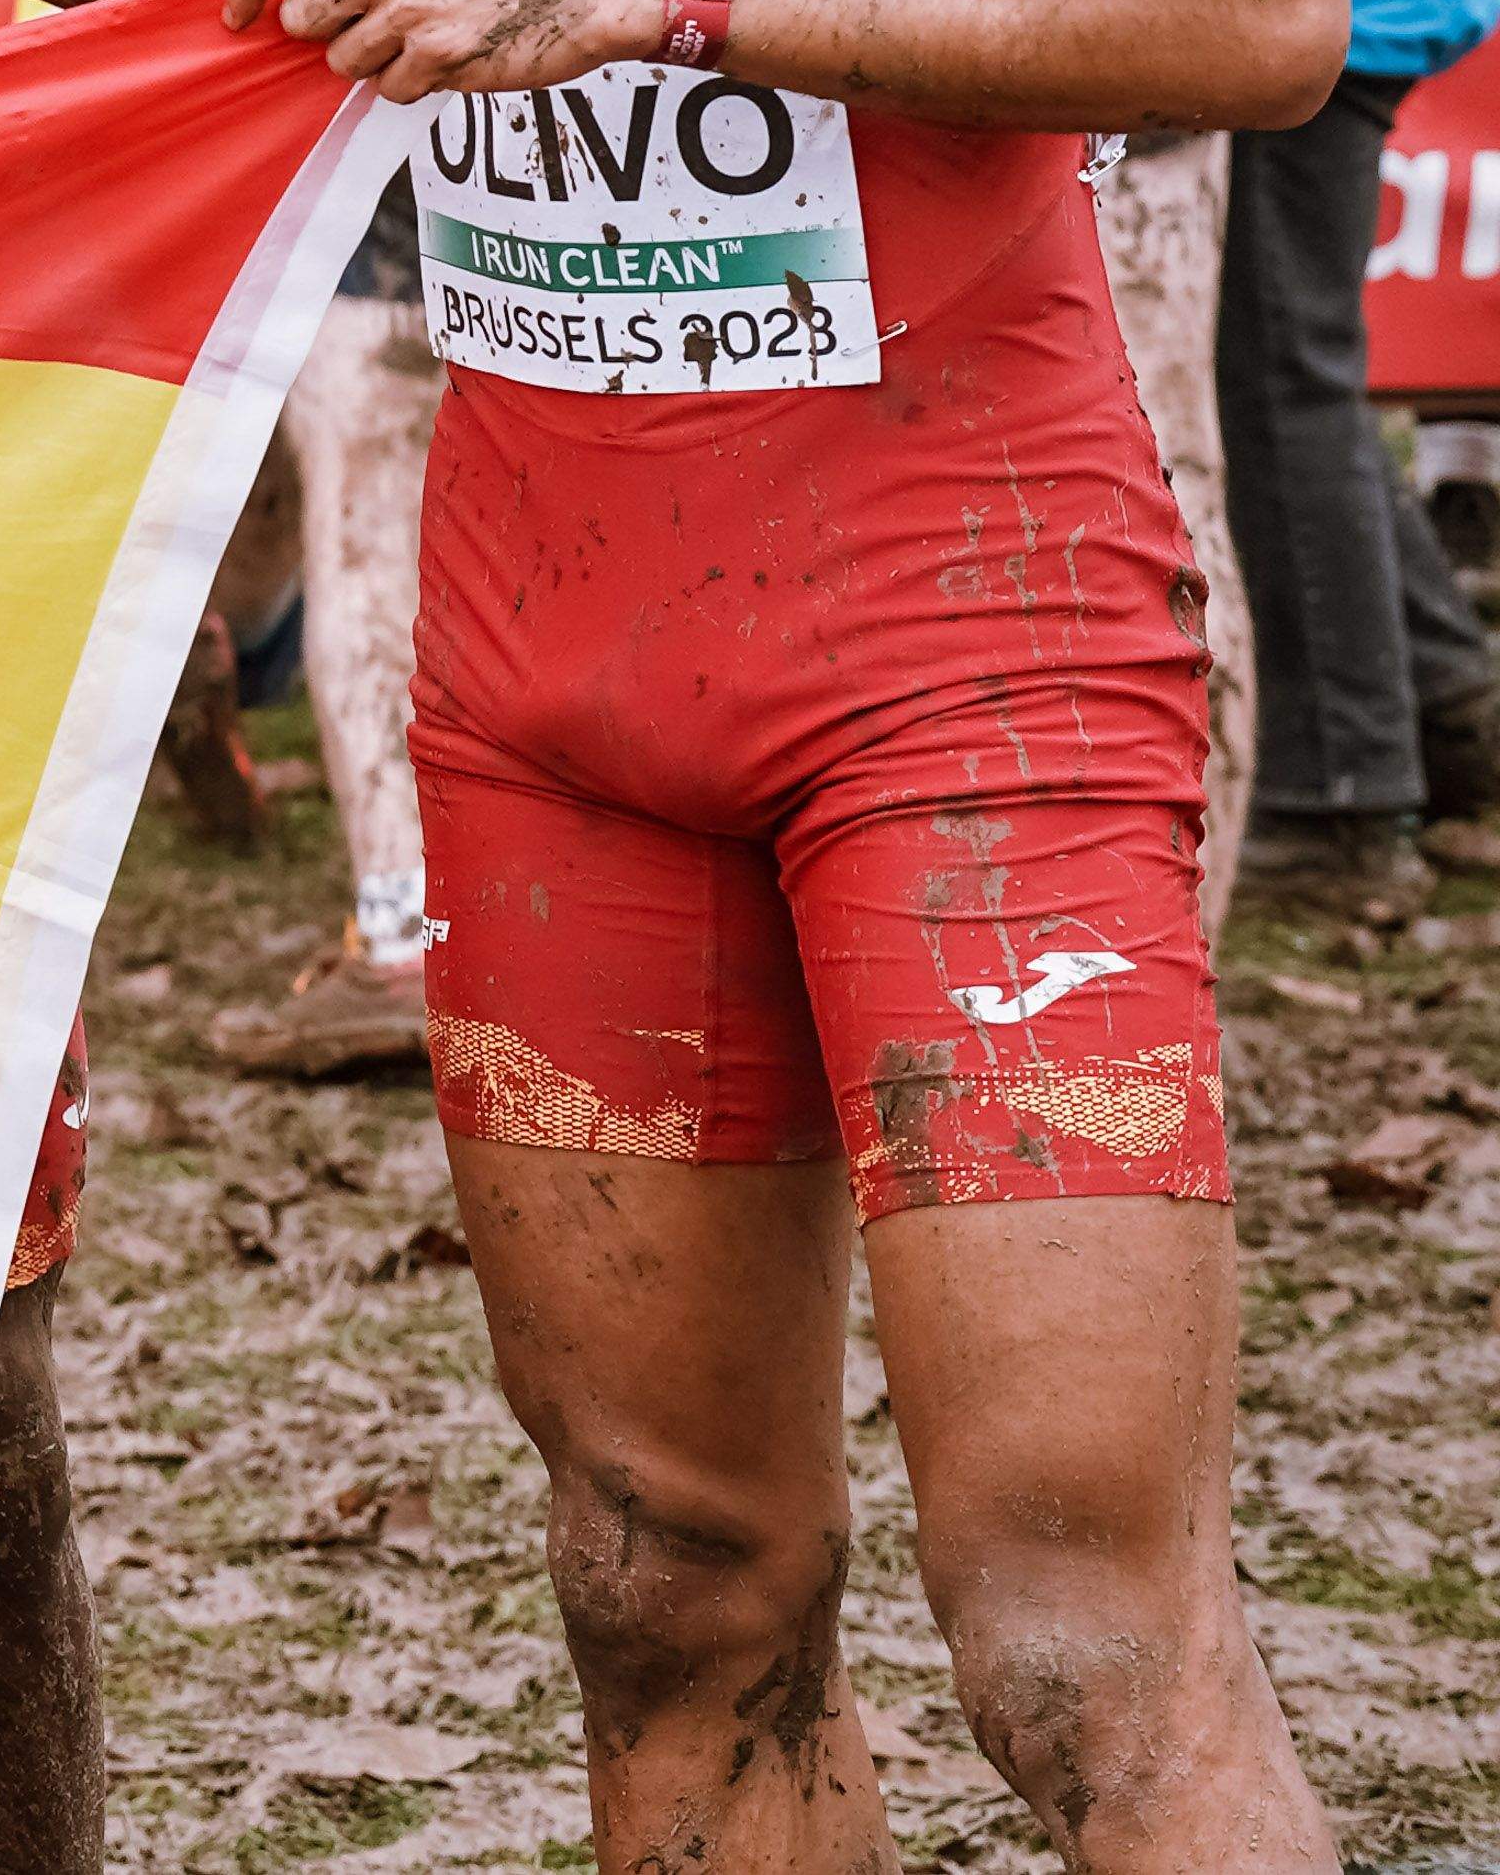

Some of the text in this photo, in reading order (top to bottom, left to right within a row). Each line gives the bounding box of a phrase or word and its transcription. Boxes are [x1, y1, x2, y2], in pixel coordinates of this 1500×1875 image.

[430, 76, 795, 202] OLIVO
[443, 285, 838, 364] BRUSSELS 2023
